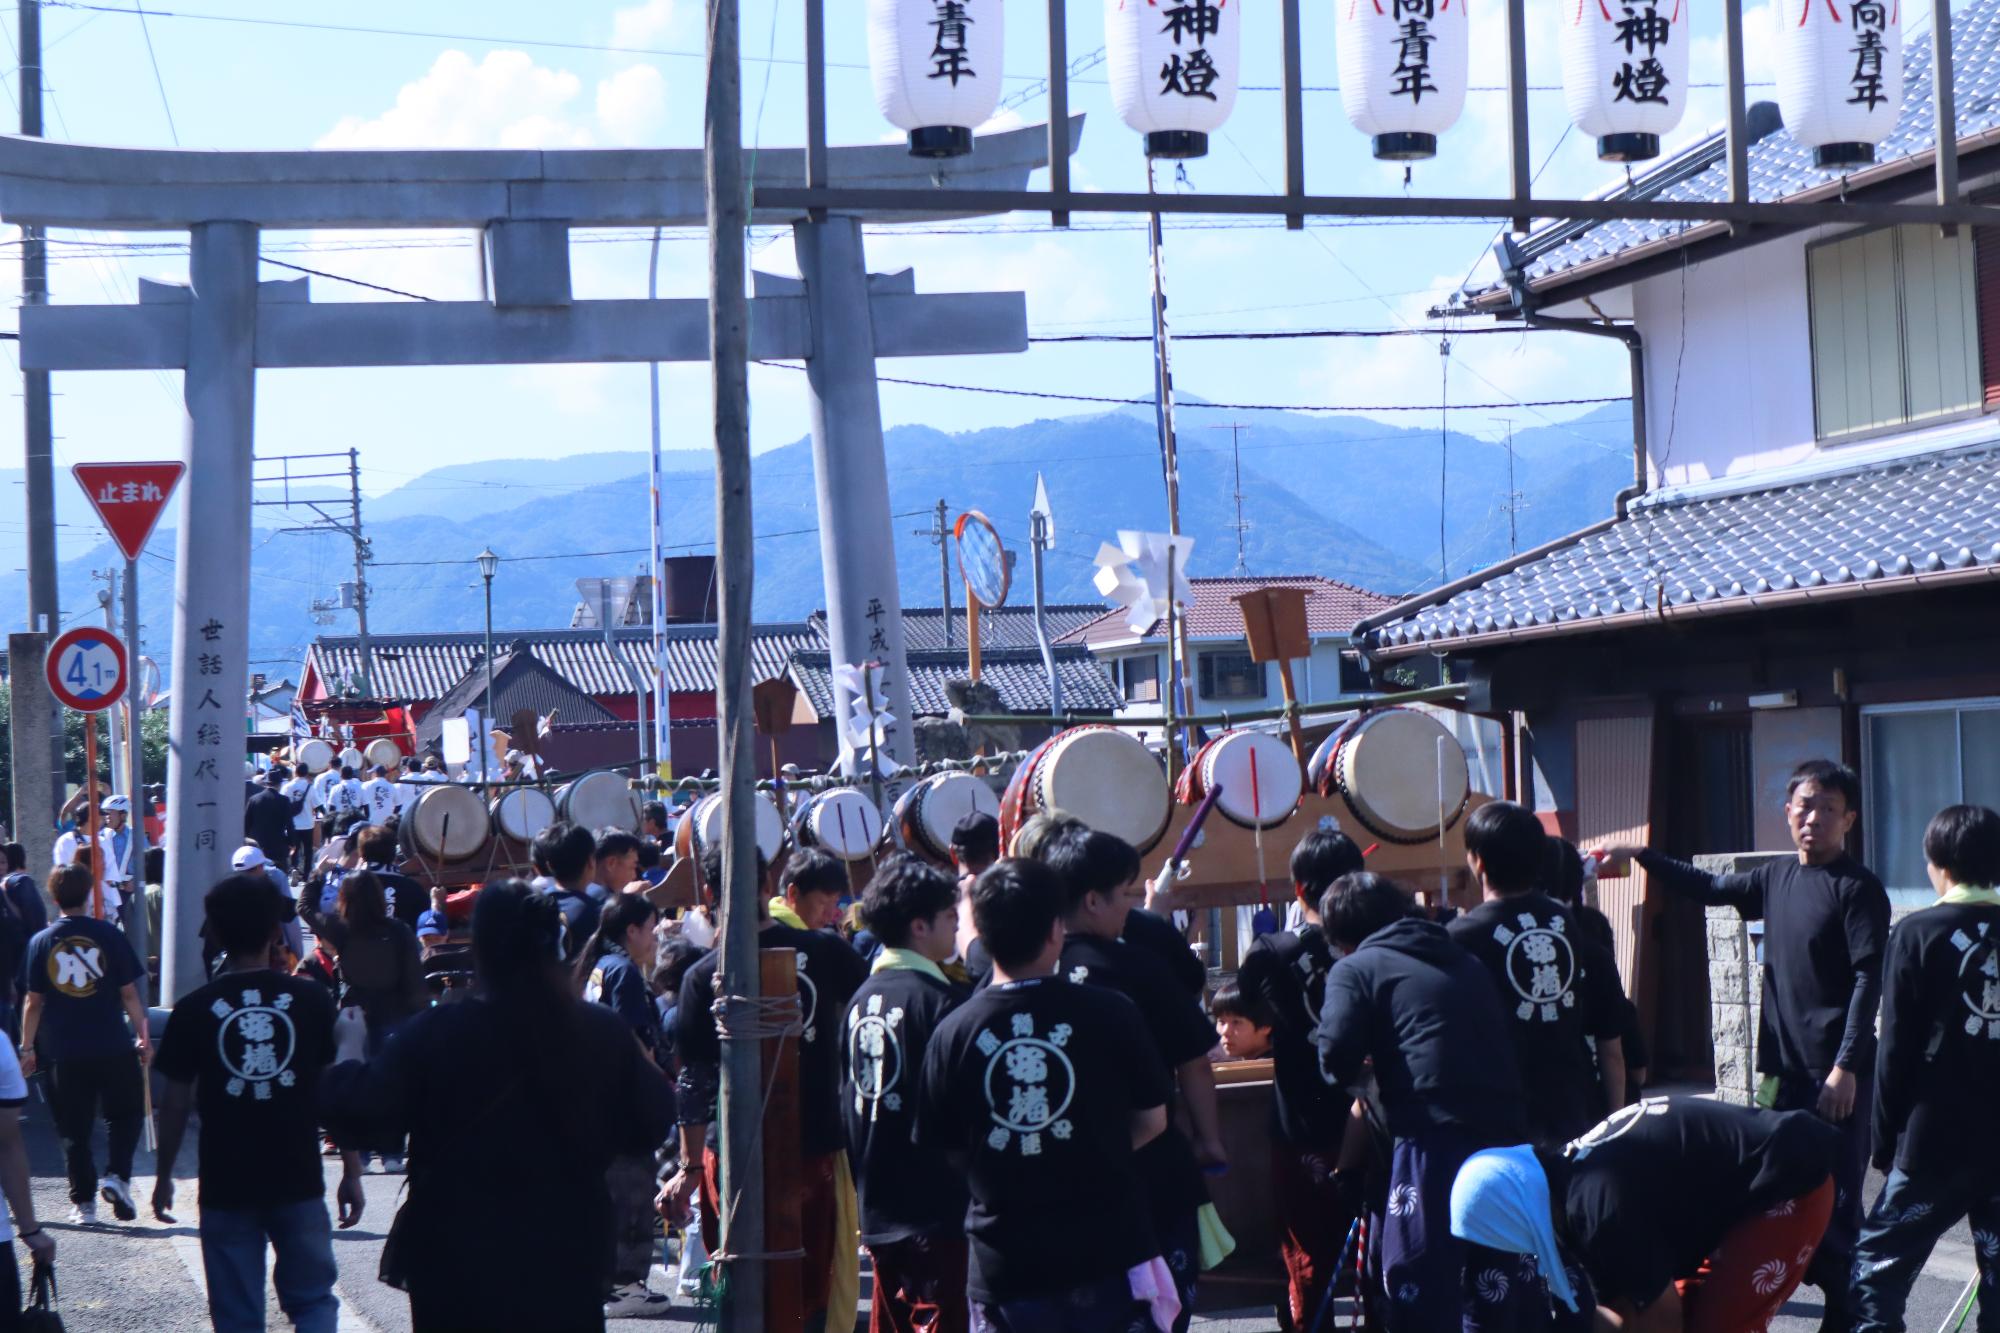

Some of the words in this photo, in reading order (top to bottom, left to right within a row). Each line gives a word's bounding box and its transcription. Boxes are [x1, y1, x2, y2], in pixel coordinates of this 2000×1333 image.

[928, 0, 976, 89] 青年
[1845, 0, 1889, 113] 向青年
[98, 480, 164, 504] 止まれ
[66, 651, 116, 687] 4.1m
[194, 617, 224, 851] 世話人総代一同
